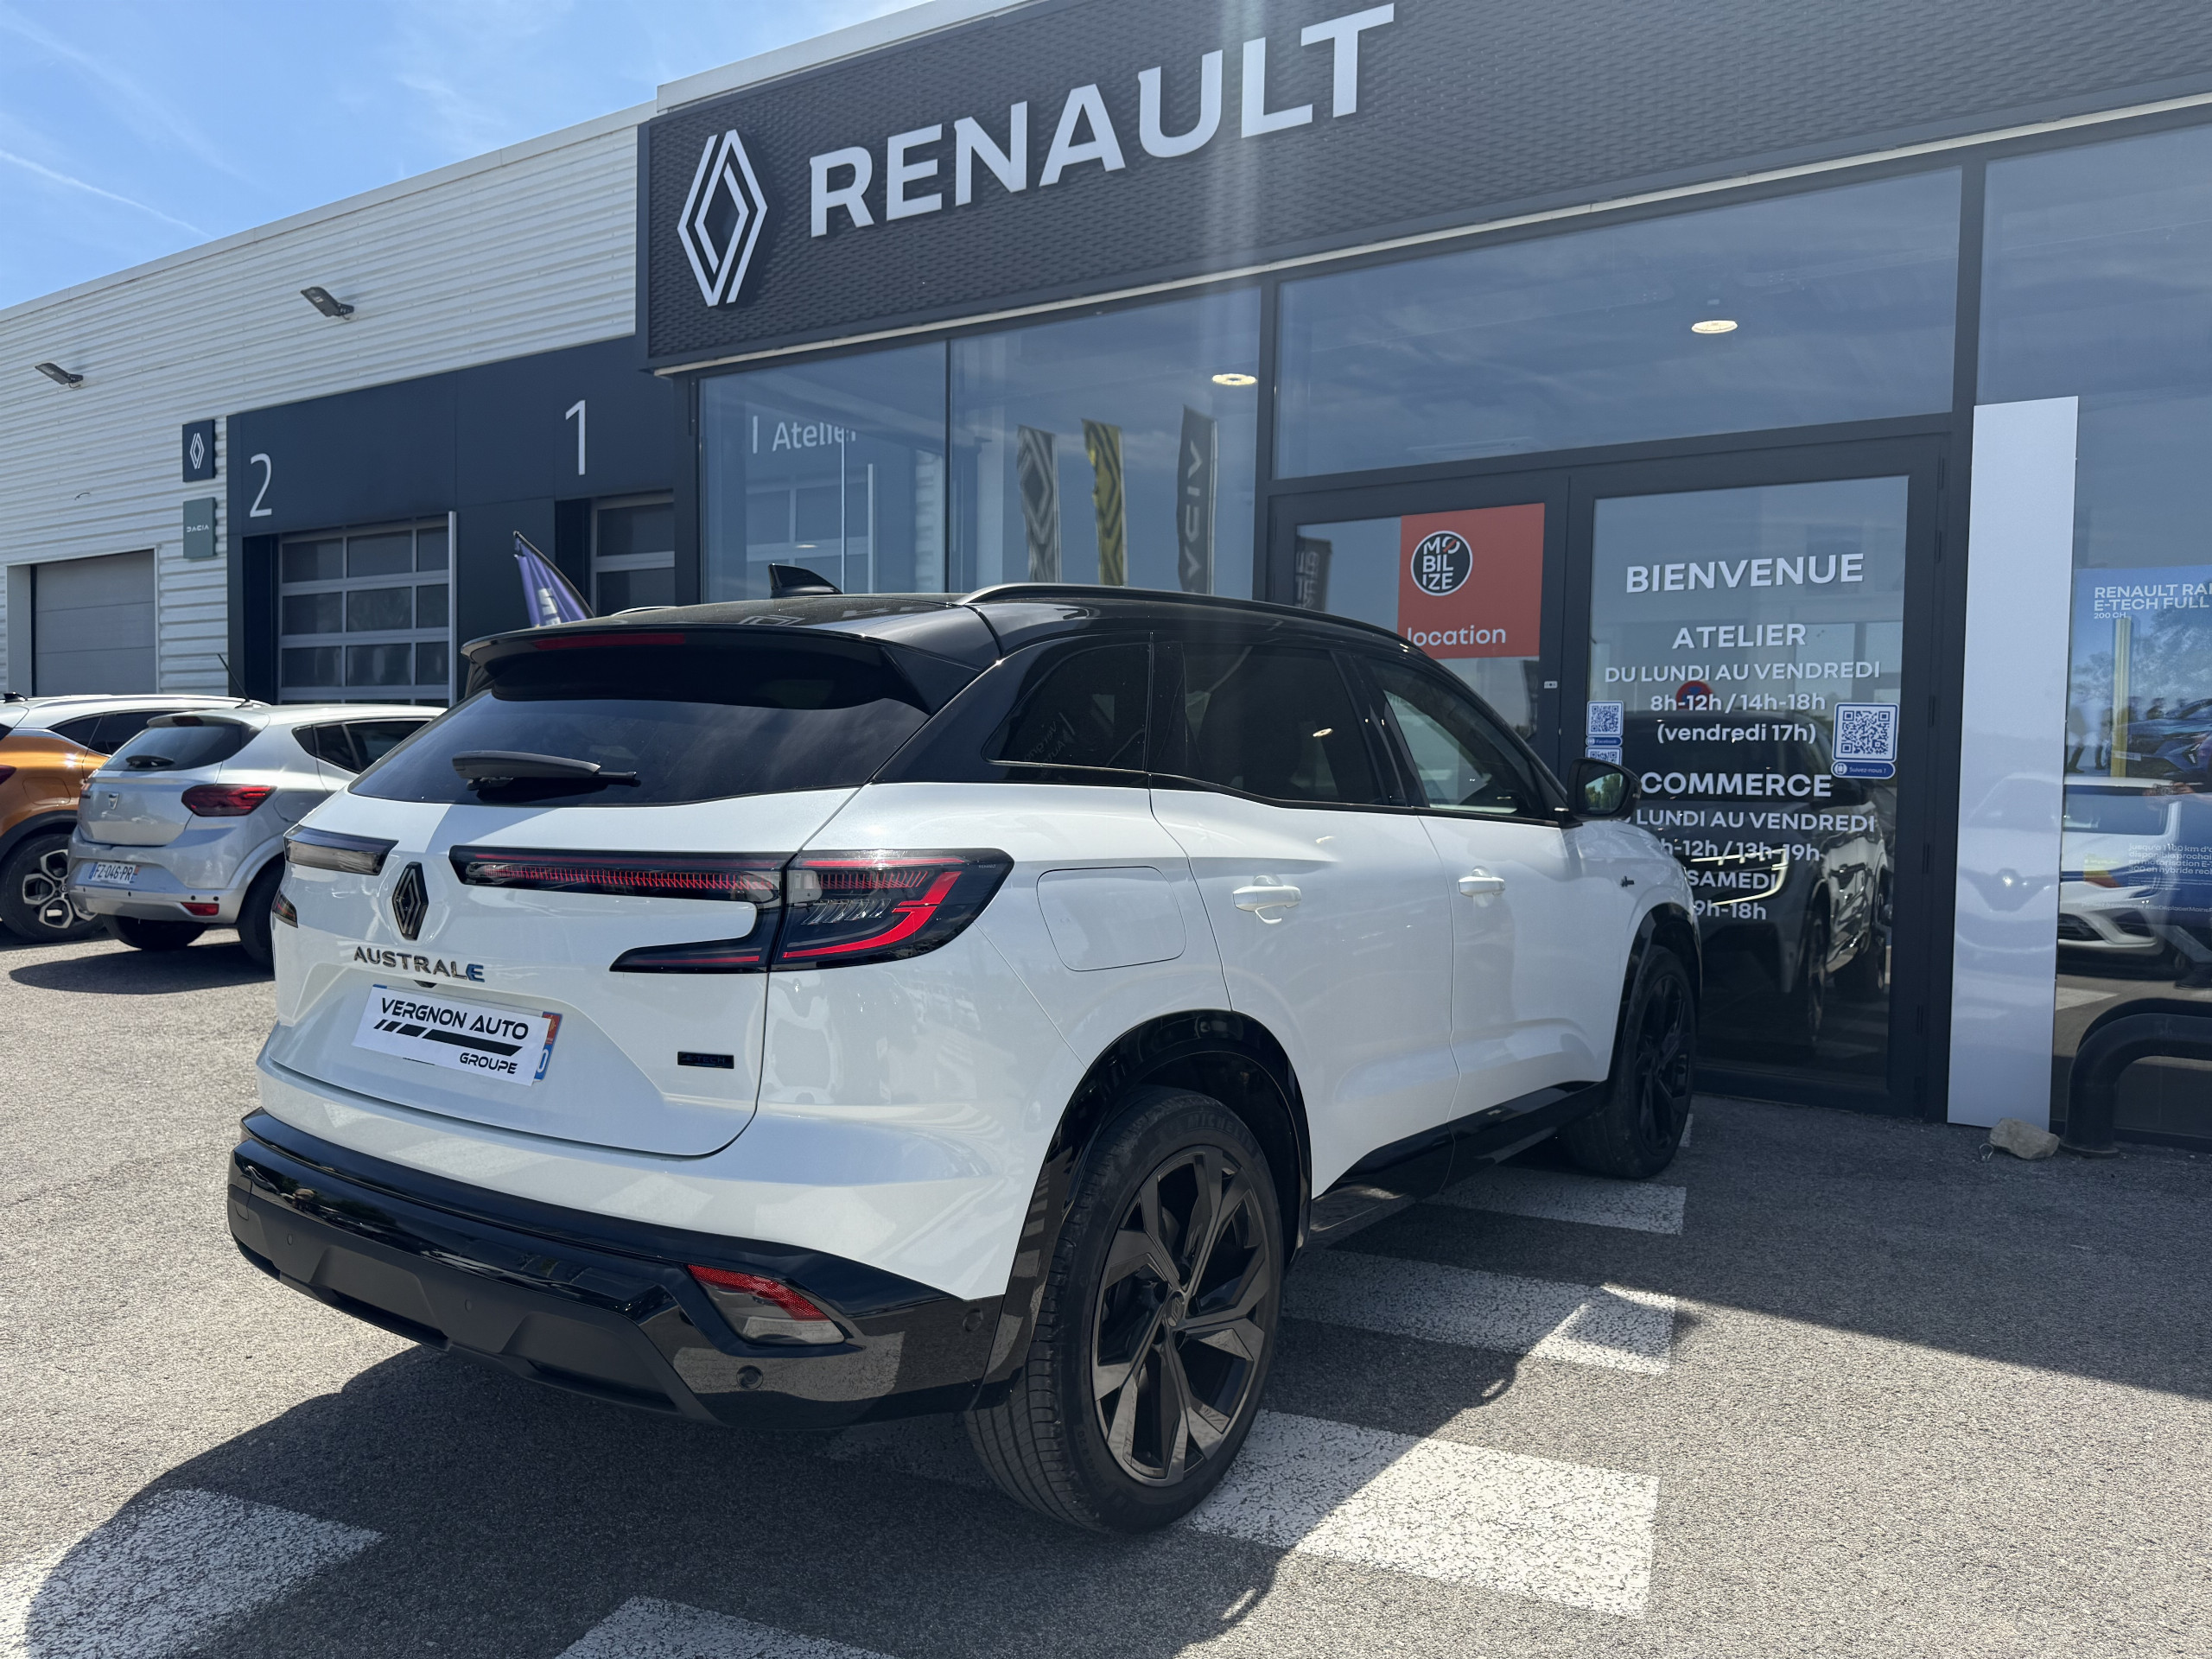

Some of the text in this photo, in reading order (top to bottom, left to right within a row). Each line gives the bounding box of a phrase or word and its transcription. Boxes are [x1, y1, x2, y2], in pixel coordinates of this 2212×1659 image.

[810, 3, 1394, 238] RENAULT
[565, 399, 586, 475] 1
[250, 453, 272, 518] 2
[186, 524, 209, 533] DACIA
[1422, 535, 1460, 556] MO
[1422, 554, 1453, 573] BIL
[1625, 553, 1864, 594] BIENVENUE
[1421, 572, 1453, 590] IZE
[2094, 584, 2178, 598] RENAULT
[2094, 596, 2209, 612] E-TECH FULL
[2112, 611, 2126, 620] CH
[1407, 624, 1506, 647] location
[1672, 623, 1807, 650] ATELIER
[1605, 661, 1880, 683] DU LUNDI AU VENDREDI
[1650, 693, 1722, 712] 8h-12h
[1742, 692, 1826, 711] 14h-18h
[1656, 723, 1816, 745] (vendredi 17h)
[1641, 772, 1832, 798] COMMERCE
[1636, 809, 1875, 833] LUNDI AU VENDREDI
[1661, 839, 1719, 858] h-12h
[1736, 841, 1820, 861] 13h-19h
[2184, 844, 2200, 853] km
[93, 864, 133, 880] FZ-046-PR
[1687, 869, 1777, 889] SAMEDI
[1694, 900, 1767, 920] 9h-18h
[353, 946, 485, 982] AUSTRALE
[380, 997, 530, 1040] VERGNON AUTO
[459, 1052, 518, 1075] GROUPE
